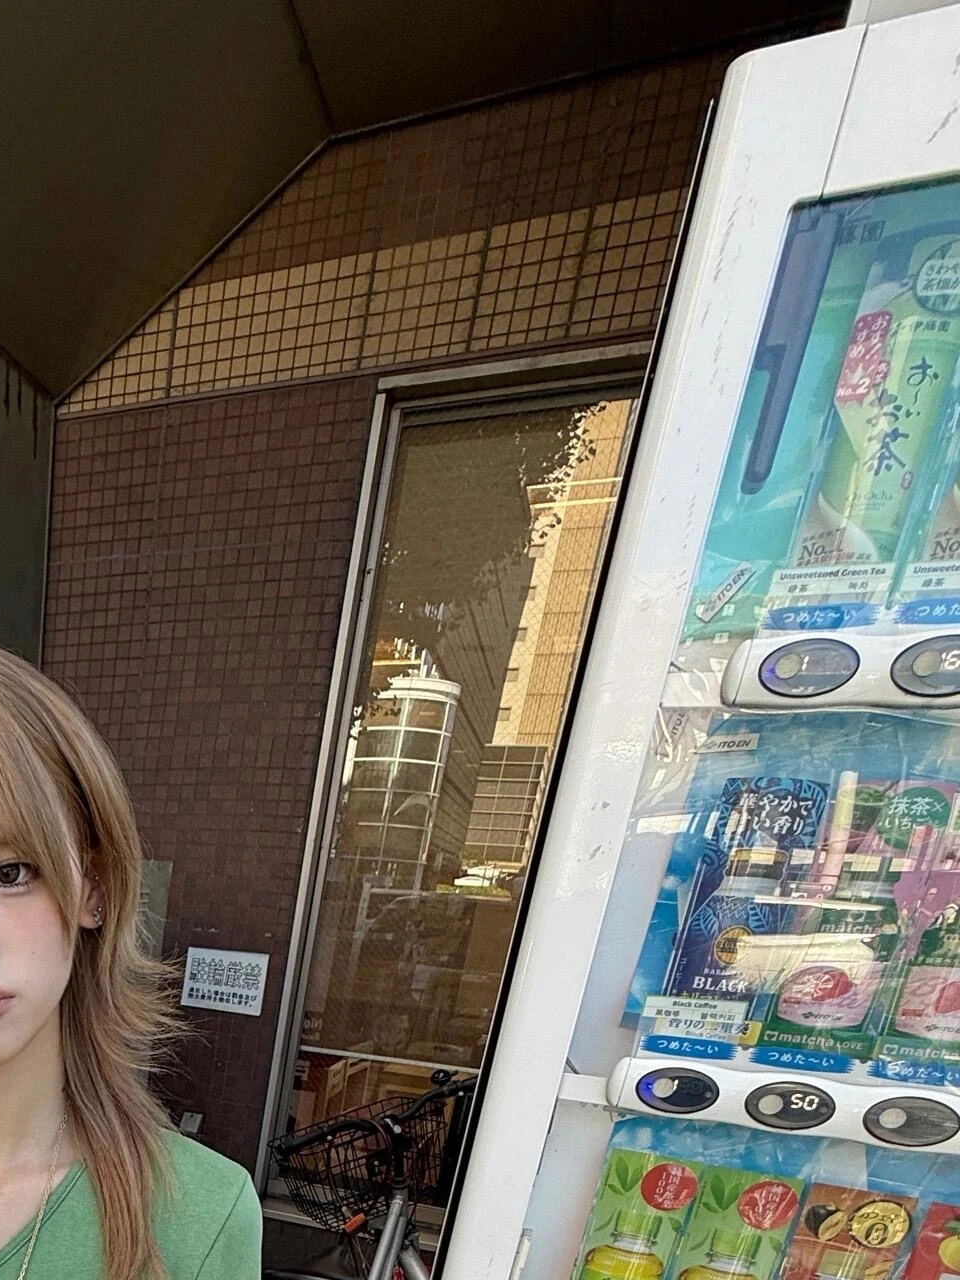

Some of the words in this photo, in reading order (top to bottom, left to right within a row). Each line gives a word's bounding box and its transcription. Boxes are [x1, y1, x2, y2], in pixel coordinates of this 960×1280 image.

[841, 568, 867, 577] Green
[870, 567, 886, 575] Tea
[189, 957, 262, 991] 駐輪厳禁
[692, 975, 749, 994] BLACK
[672, 1000, 692, 1009] Black
[693, 1002, 718, 1010] Coffee
[778, 1032, 834, 1047] matcha
[836, 1039, 864, 1050] LOVE
